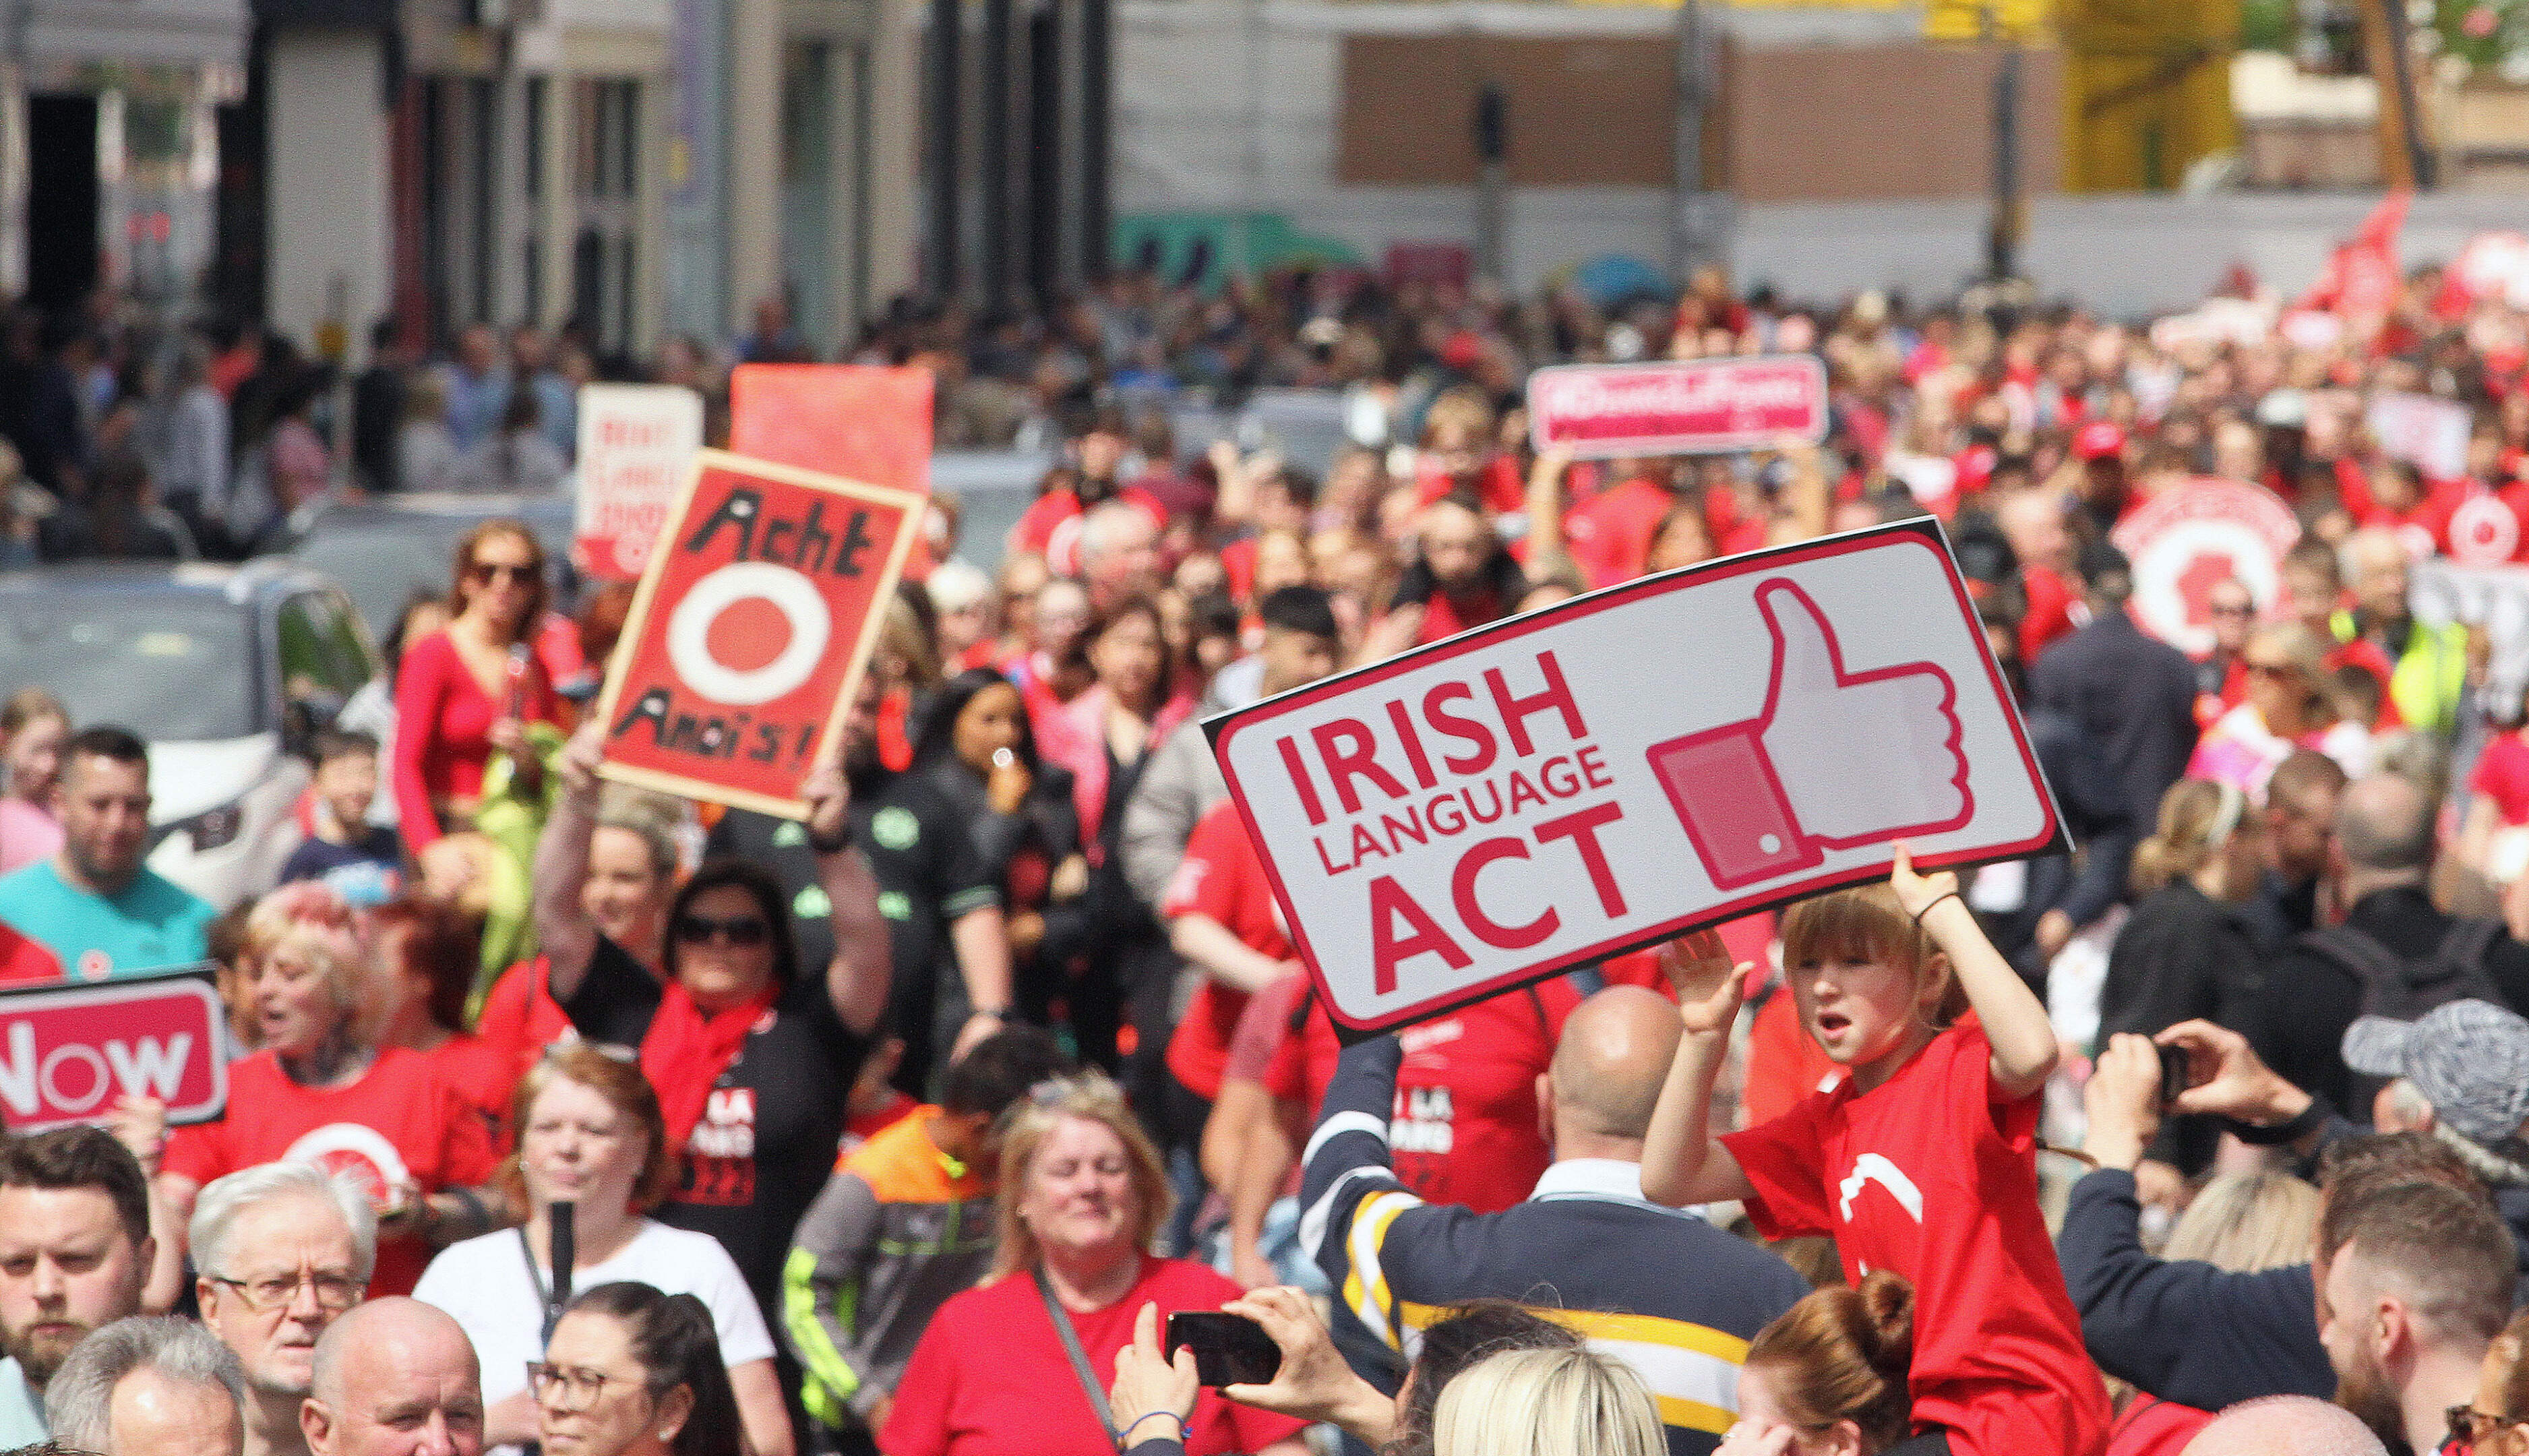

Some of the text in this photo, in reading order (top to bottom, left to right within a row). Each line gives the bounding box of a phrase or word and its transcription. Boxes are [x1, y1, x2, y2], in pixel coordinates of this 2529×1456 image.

[683, 487, 875, 577] Acht
[1276, 649, 1588, 826] IRISH
[1312, 744, 1614, 877] LANGUAGE
[1368, 800, 1628, 996] ACT
